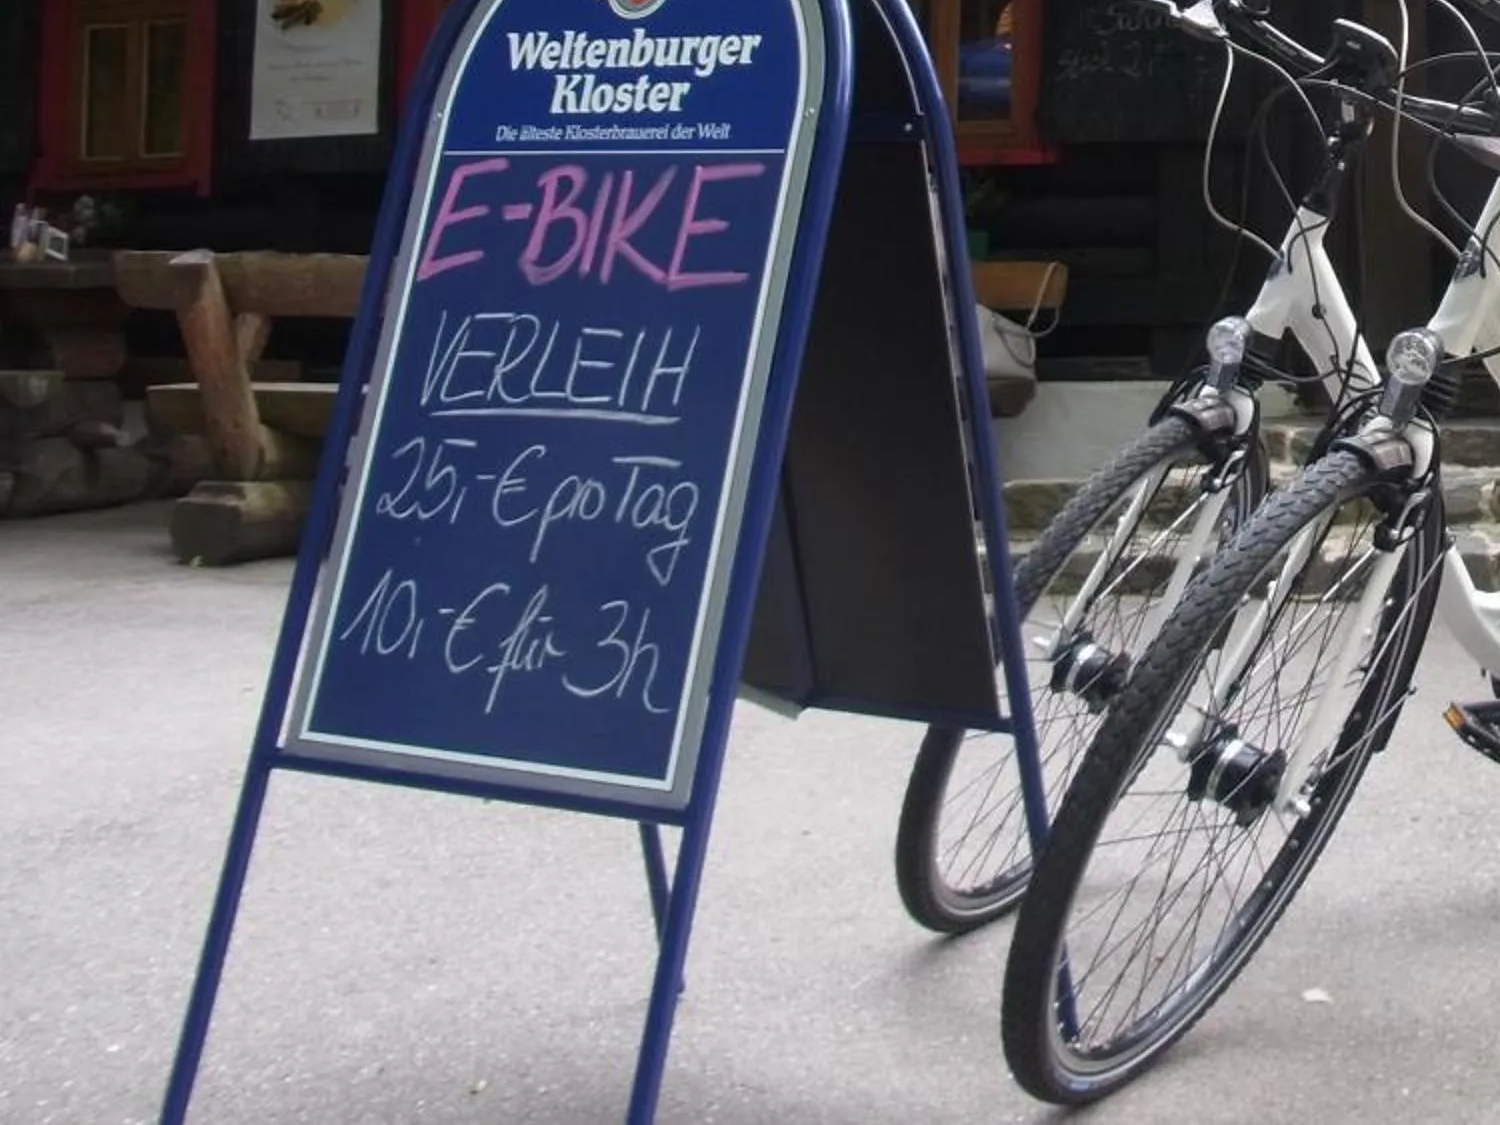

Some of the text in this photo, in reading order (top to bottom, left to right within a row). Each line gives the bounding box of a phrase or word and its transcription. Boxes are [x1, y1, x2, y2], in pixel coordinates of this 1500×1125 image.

[507, 28, 762, 77] Weltenburger
[550, 74, 691, 114] Kloster
[496, 122, 732, 142] Die älteste Klosterbrauerei der Welt
[417, 158, 765, 292] E-BIKE
[420, 309, 701, 412] VERLEIH
[529, 475, 606, 563] pro
[612, 455, 699, 586] Tag
[485, 584, 568, 715] für
